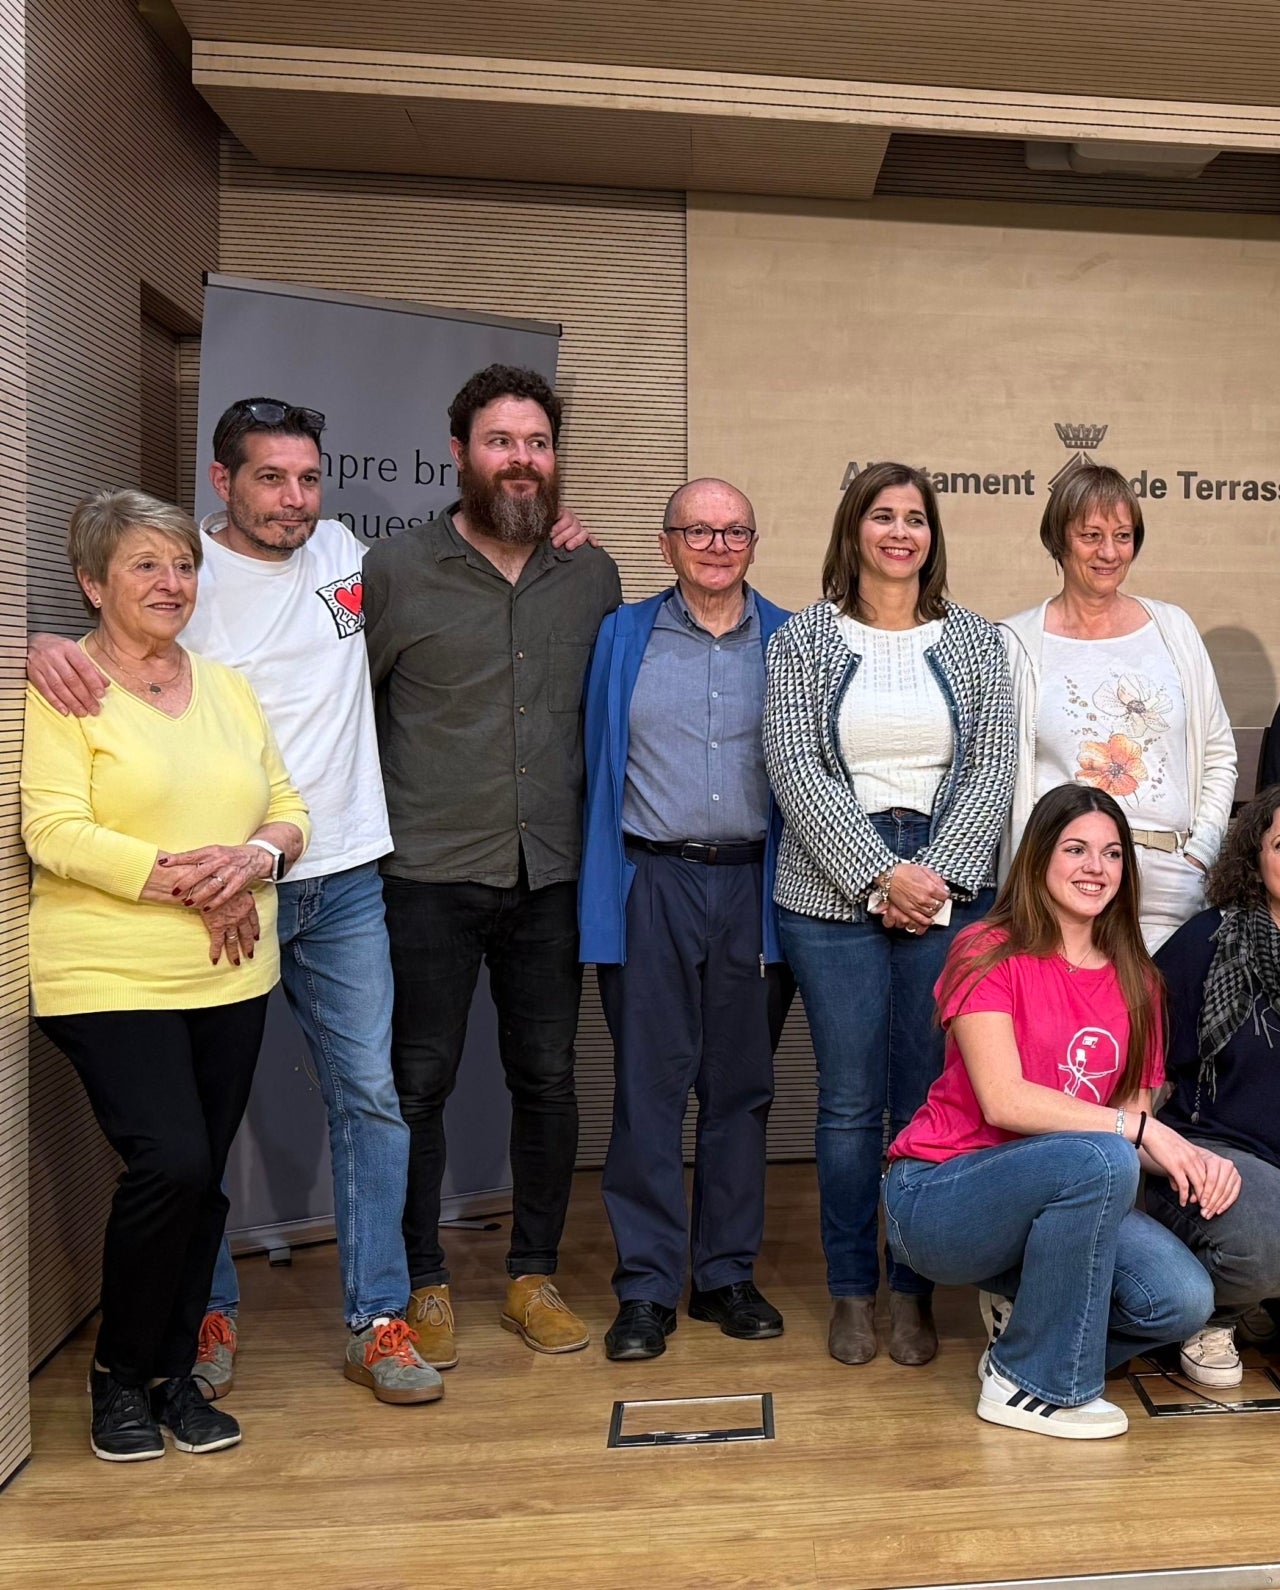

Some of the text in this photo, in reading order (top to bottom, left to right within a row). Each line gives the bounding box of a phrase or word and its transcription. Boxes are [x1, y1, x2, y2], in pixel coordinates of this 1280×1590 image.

[321, 449, 461, 489] pre br
[1129, 470, 1168, 499] de
